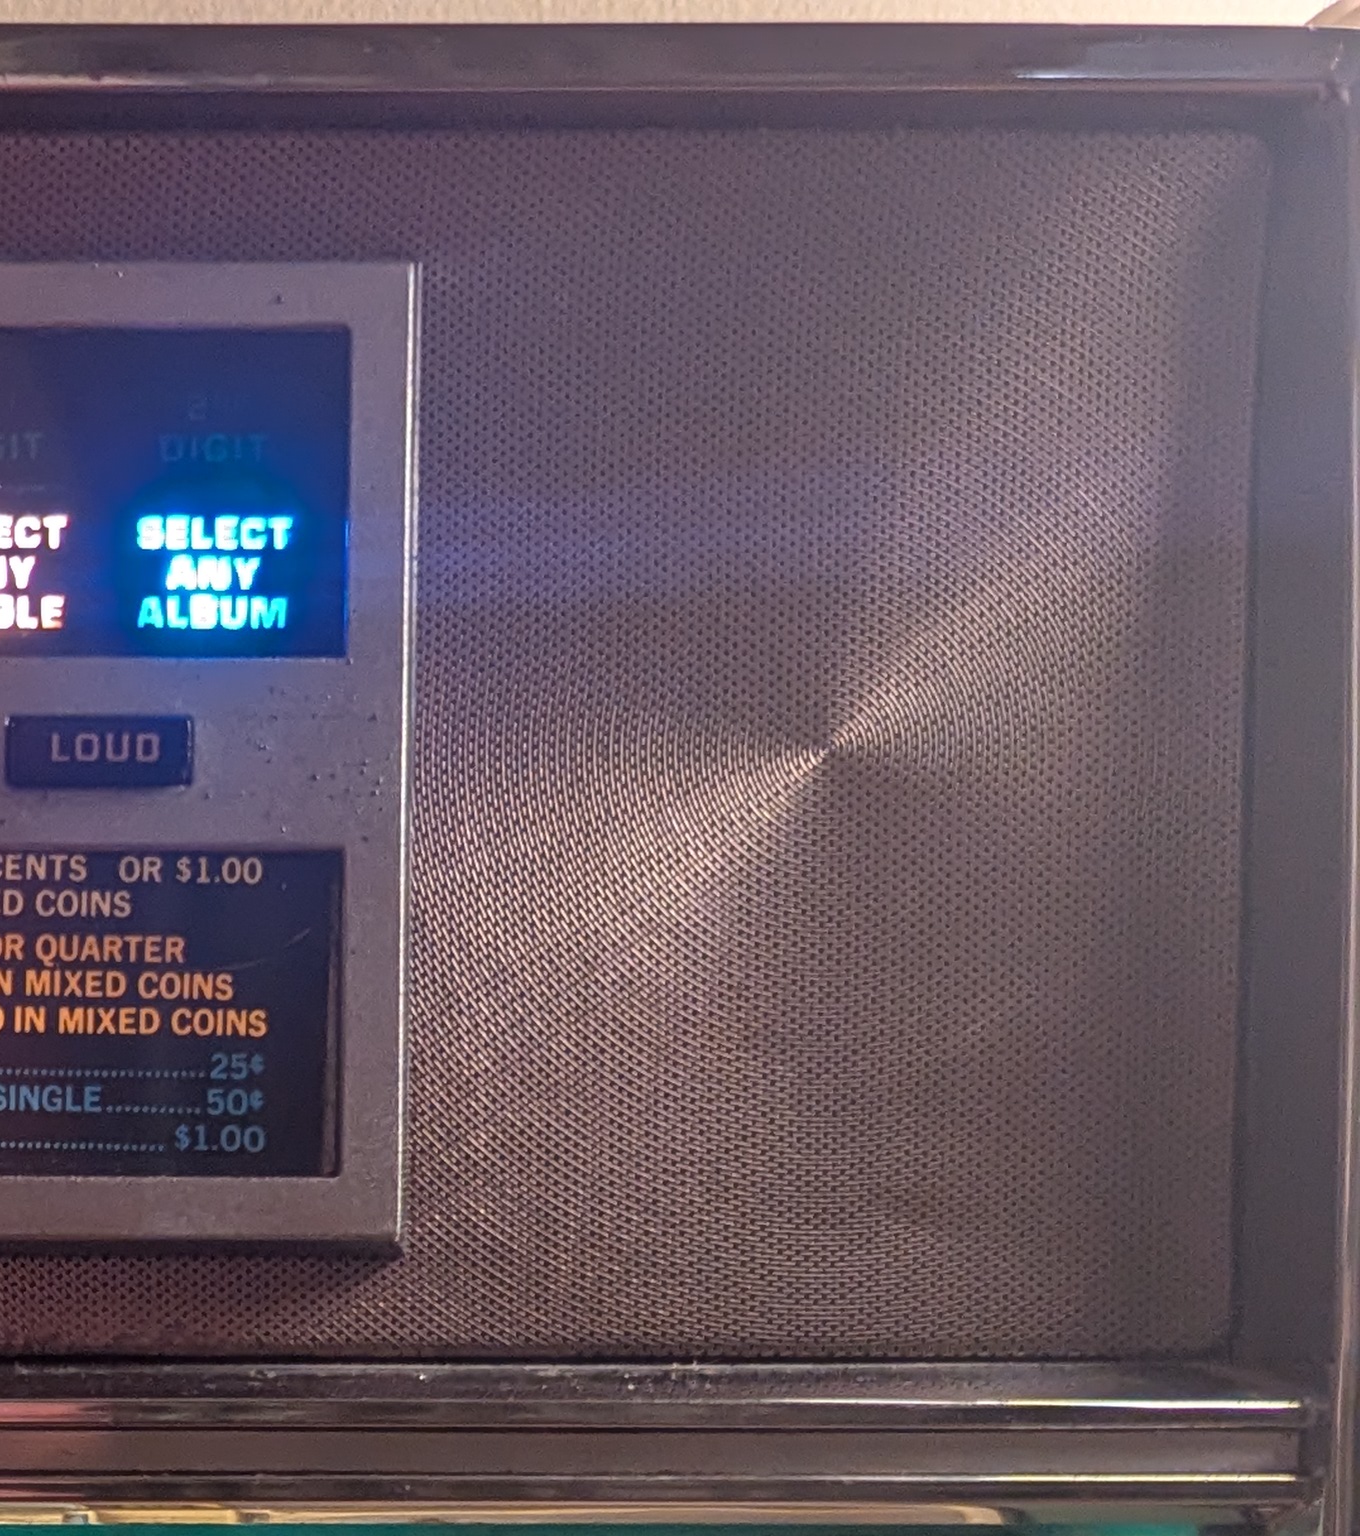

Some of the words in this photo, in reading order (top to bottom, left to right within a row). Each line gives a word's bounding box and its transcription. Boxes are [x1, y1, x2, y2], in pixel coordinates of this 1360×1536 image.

[137, 515, 293, 551] SELECT
[165, 556, 260, 591] ANY
[138, 596, 287, 629] ALBUM
[51, 731, 161, 762] LOUD
[118, 855, 162, 883] OR
[175, 856, 263, 884] $1.00
[35, 889, 131, 917] COINS
[35, 933, 185, 967] QUARTER
[25, 969, 126, 998] MIXED
[138, 972, 233, 1001] COINS
[14, 1005, 46, 1033] IN
[58, 1006, 161, 1035] MIXED
[171, 1008, 267, 1037] COINS
[209, 1052, 264, 1080] 25¢
[207, 1088, 264, 1116] 50¢
[174, 1123, 265, 1153] $1.00
